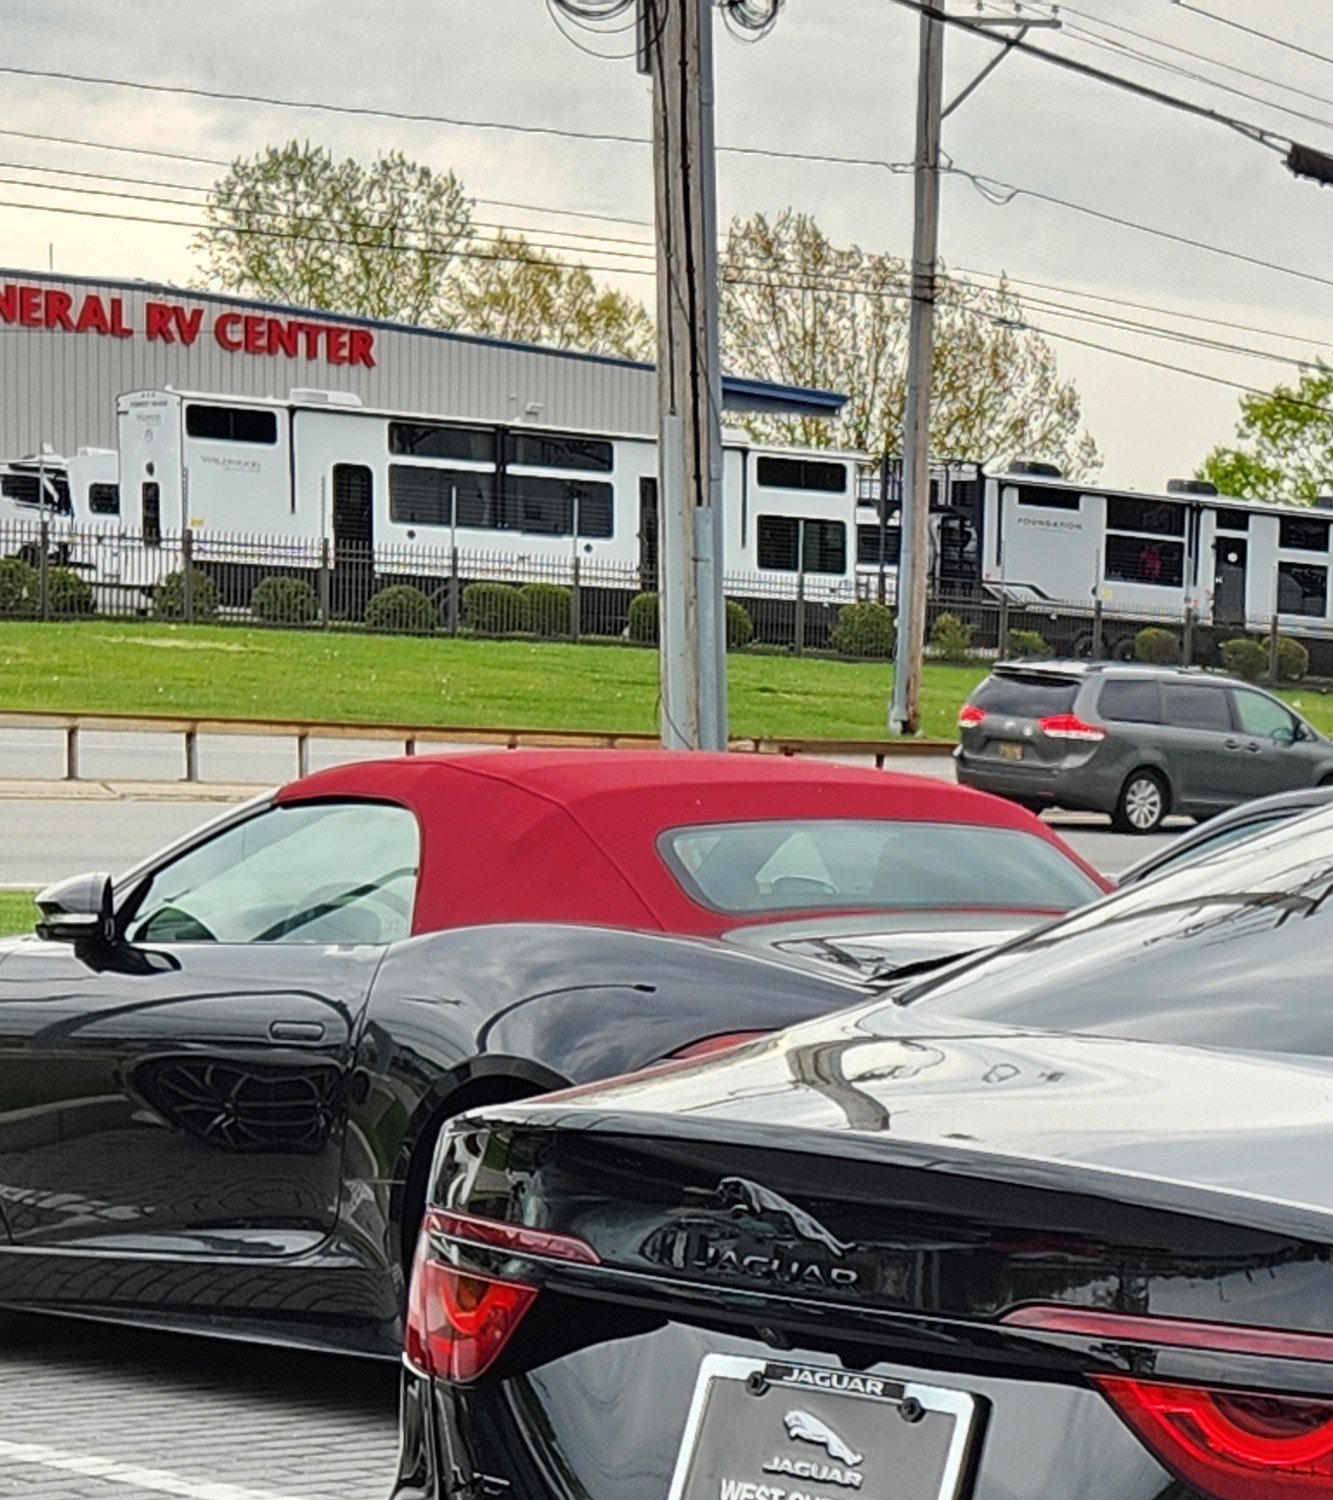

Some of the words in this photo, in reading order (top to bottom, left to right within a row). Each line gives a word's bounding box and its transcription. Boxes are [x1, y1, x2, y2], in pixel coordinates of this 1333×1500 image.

[146, 301, 204, 346] RV
[214, 312, 376, 369] CENTER
[693, 1247, 860, 1292] JAGUAR
[783, 1368, 885, 1396] JAGUAR
[762, 1456, 863, 1488] JAGUAR
